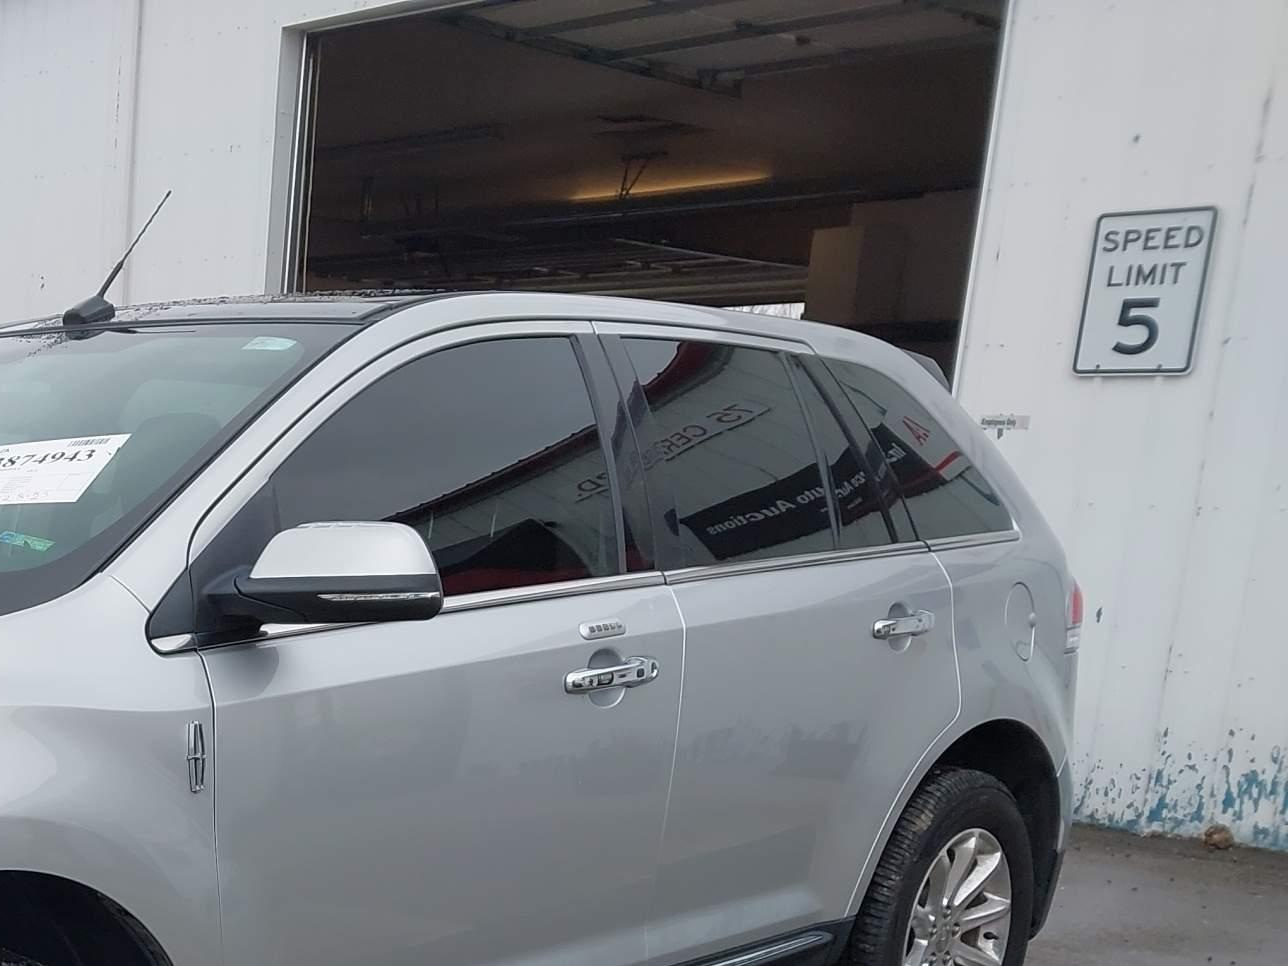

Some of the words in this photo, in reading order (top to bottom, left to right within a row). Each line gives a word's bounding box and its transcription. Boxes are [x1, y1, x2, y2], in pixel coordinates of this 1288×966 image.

[1103, 226, 1204, 252] SPEED
[1107, 262, 1187, 287] LIMIT
[1112, 297, 1160, 355] 5
